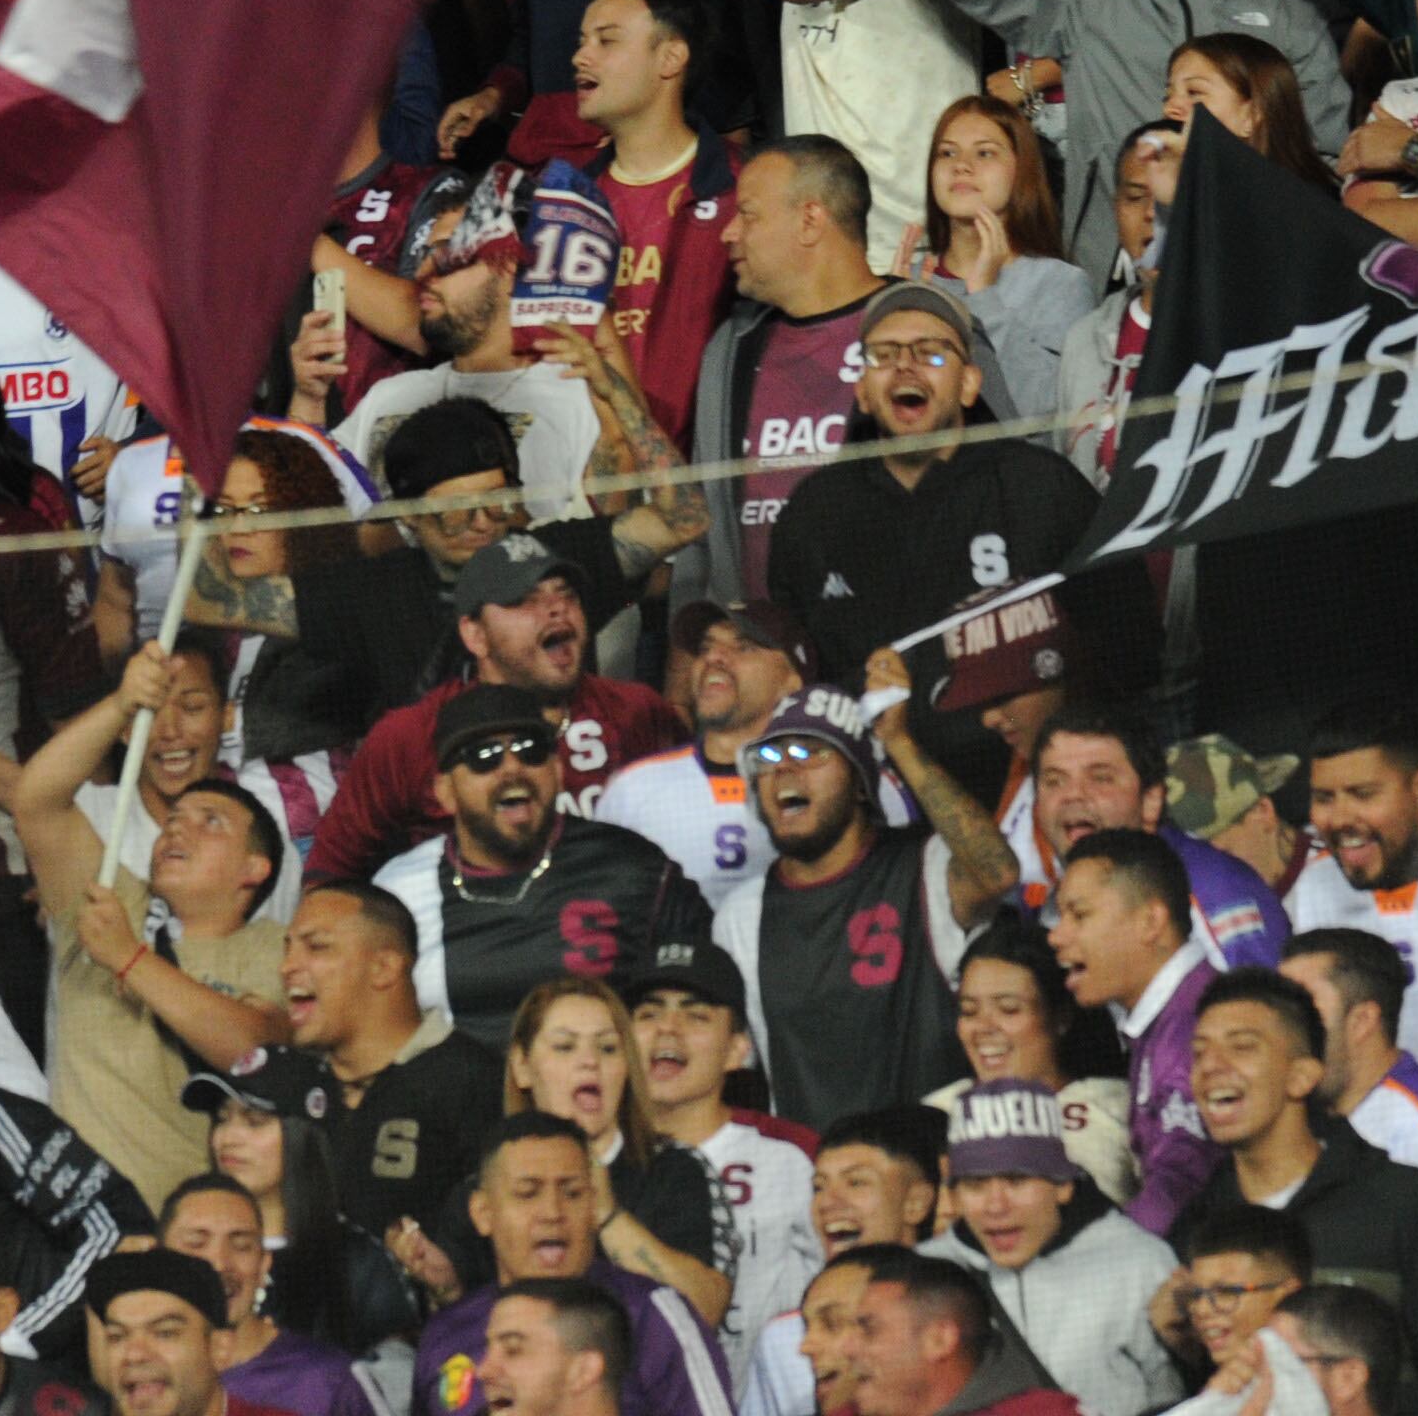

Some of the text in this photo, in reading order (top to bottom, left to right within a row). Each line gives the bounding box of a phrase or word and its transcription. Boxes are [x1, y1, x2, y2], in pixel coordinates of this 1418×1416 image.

[355, 188, 393, 223] S
[523, 224, 612, 287] 16
[516, 301, 595, 316] SAPRISSA
[757, 414, 846, 458] BAC
[969, 533, 1010, 588] S
[565, 718, 608, 772] S
[714, 824, 748, 870] S
[559, 899, 619, 976] S
[847, 903, 903, 987] S
[1062, 1102, 1089, 1132] S
[372, 1118, 419, 1180] S
[720, 1163, 753, 1206] S
